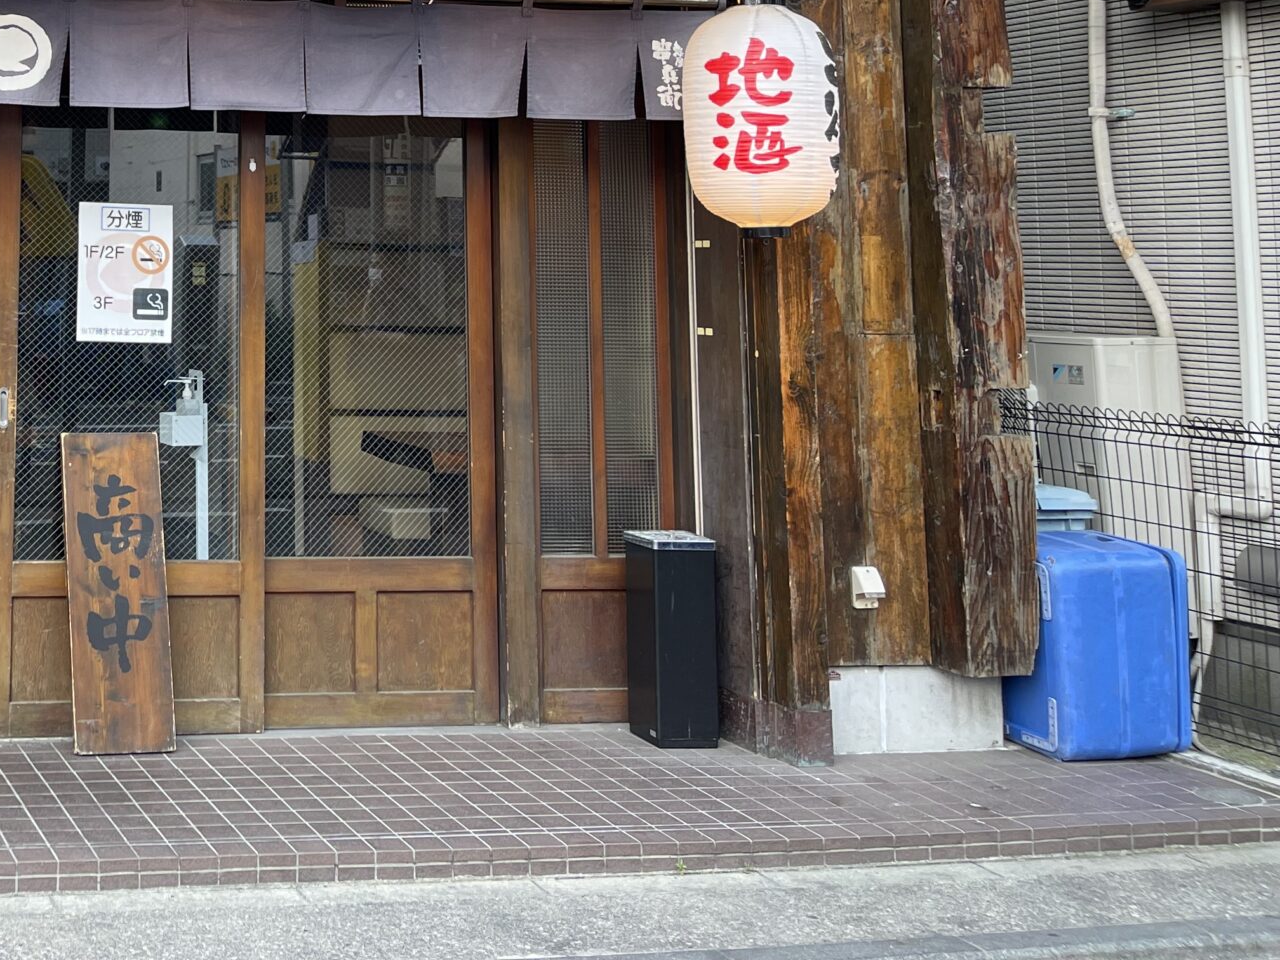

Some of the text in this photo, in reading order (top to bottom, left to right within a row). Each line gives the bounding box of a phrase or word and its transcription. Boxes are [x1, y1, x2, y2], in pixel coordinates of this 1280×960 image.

[704, 37, 803, 174] 地酒
[106, 209, 144, 229] 分煙
[83, 244, 126, 260] 1F/2F
[93, 296, 114, 310] 3F
[76, 474, 155, 673] 商い中
